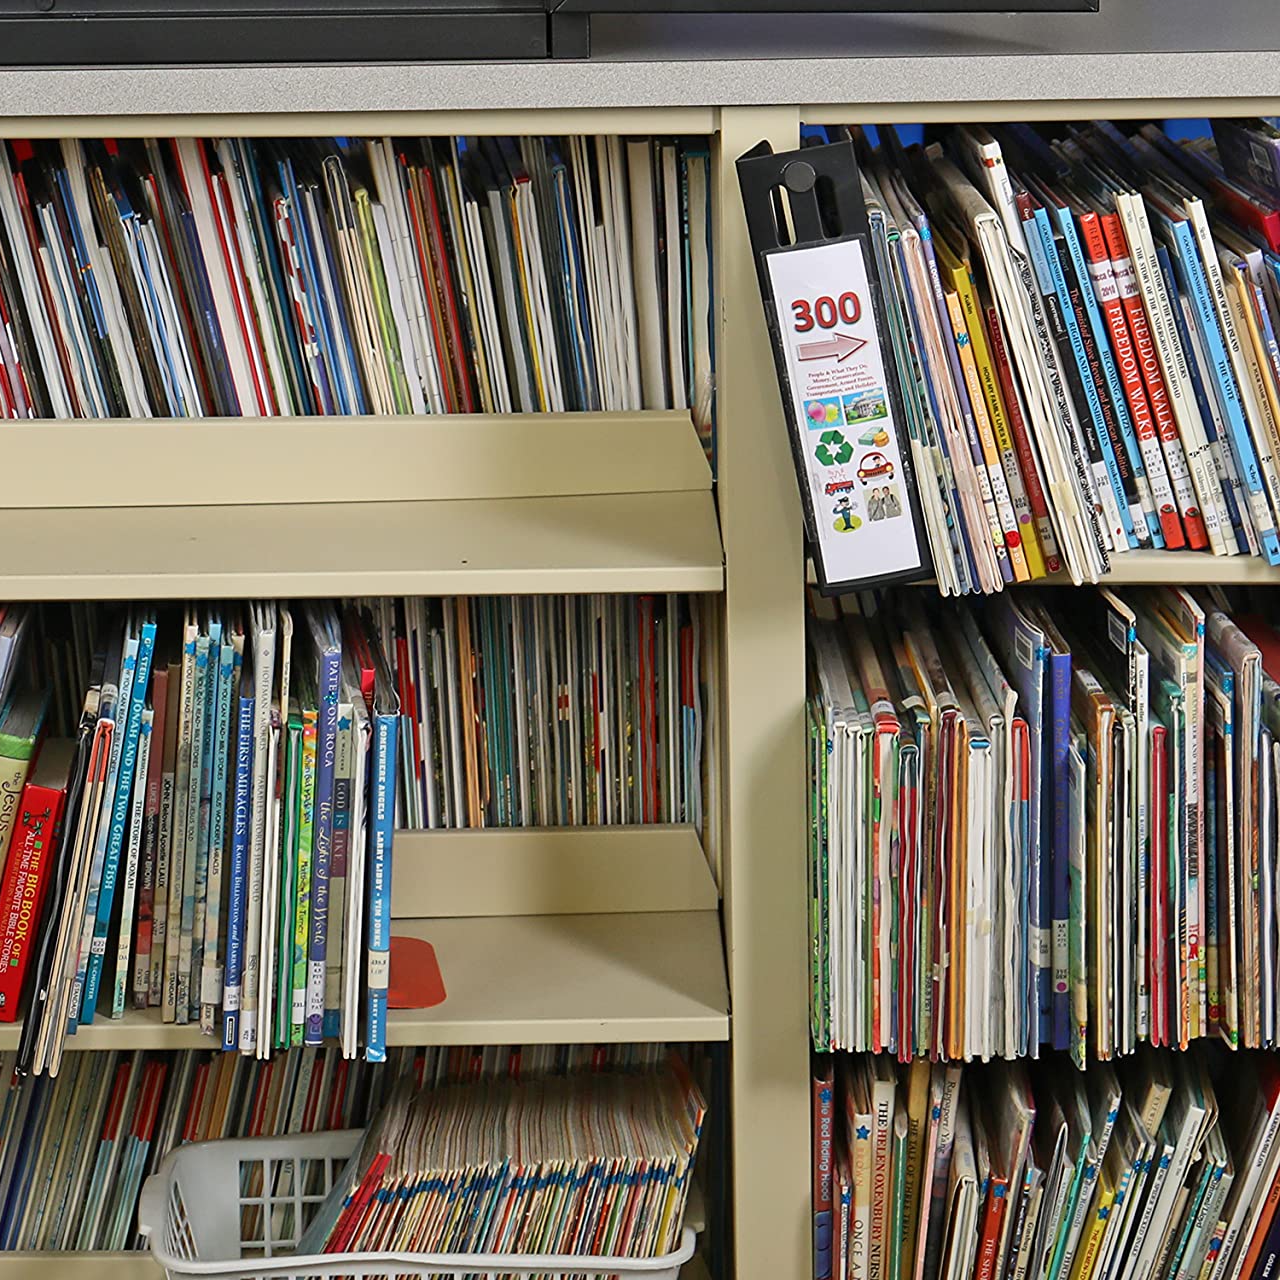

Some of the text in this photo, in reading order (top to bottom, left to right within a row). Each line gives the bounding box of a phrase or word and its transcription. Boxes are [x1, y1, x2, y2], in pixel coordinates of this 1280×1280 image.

[791, 291, 862, 333] 300
[963, 293, 974, 314] Kuklin
[1148, 253, 1187, 378] THE STORY OF THE FREEDOM RIDERS
[1040, 223, 1050, 243] GOOD
[1046, 243, 1061, 281] CITIZENSHIP
[1058, 282, 1070, 310] LIBRARY
[1068, 320, 1083, 353] RIGHTS
[1078, 354, 1088, 370] AND
[1083, 370, 1108, 446] RESPONSIBILITIES
[1065, 222, 1075, 241] GOOD
[1071, 242, 1087, 281] CITIZENSHIP
[1082, 281, 1094, 308] LIBRARY
[1102, 350, 1120, 395] BECOMING
[1117, 404, 1132, 437] CITIZEN
[1108, 306, 1139, 383] FREEDOM
[1130, 307, 1161, 384] FREEDOM
[981, 365, 991, 383] HOW
[986, 384, 994, 394] MY
[1069, 287, 1130, 477] The Amistad Slave Revolt and American Abolition
[988, 393, 1000, 418] FAMILY
[995, 417, 1005, 436] LIVES
[1000, 437, 1007, 445] IN
[324, 660, 340, 768] PATEON ROCA
[234, 703, 252, 834] THE FIRST MIRACLES
[378, 725, 387, 781] SOMEWHERE
[104, 698, 143, 889] JONAH AND THE TWO GREAT FISH
[335, 782, 345, 808] GOD
[376, 785, 385, 819] ANGELS
[334, 814, 343, 825] IS
[20, 830, 36, 868] ALL-TIME
[126, 800, 142, 889] THE STORY OF JONAH
[234, 844, 243, 874] RACHEL
[316, 827, 332, 863] Light
[376, 831, 384, 860] LARRY
[11, 870, 27, 910] FAVORITE
[316, 868, 329, 879] of
[375, 863, 383, 889] LIBBY
[12, 850, 41, 958] THE BIG BOOK OF
[231, 876, 241, 922] BILLINGTON
[317, 886, 325, 905] the
[6, 912, 18, 936] BIBLE
[313, 908, 327, 943] World
[69, 982, 81, 1017] STANDARD
[878, 1101, 888, 1125] THE
[819, 1140, 830, 1170] Riding
[875, 1129, 886, 1171] HELEN
[821, 1173, 829, 1201] Hood
[871, 1174, 884, 1240] OXENBURY
[1131, 1183, 1160, 1257] SPIDER TRICKED SNAKE
[852, 1220, 863, 1271] ONCE A
